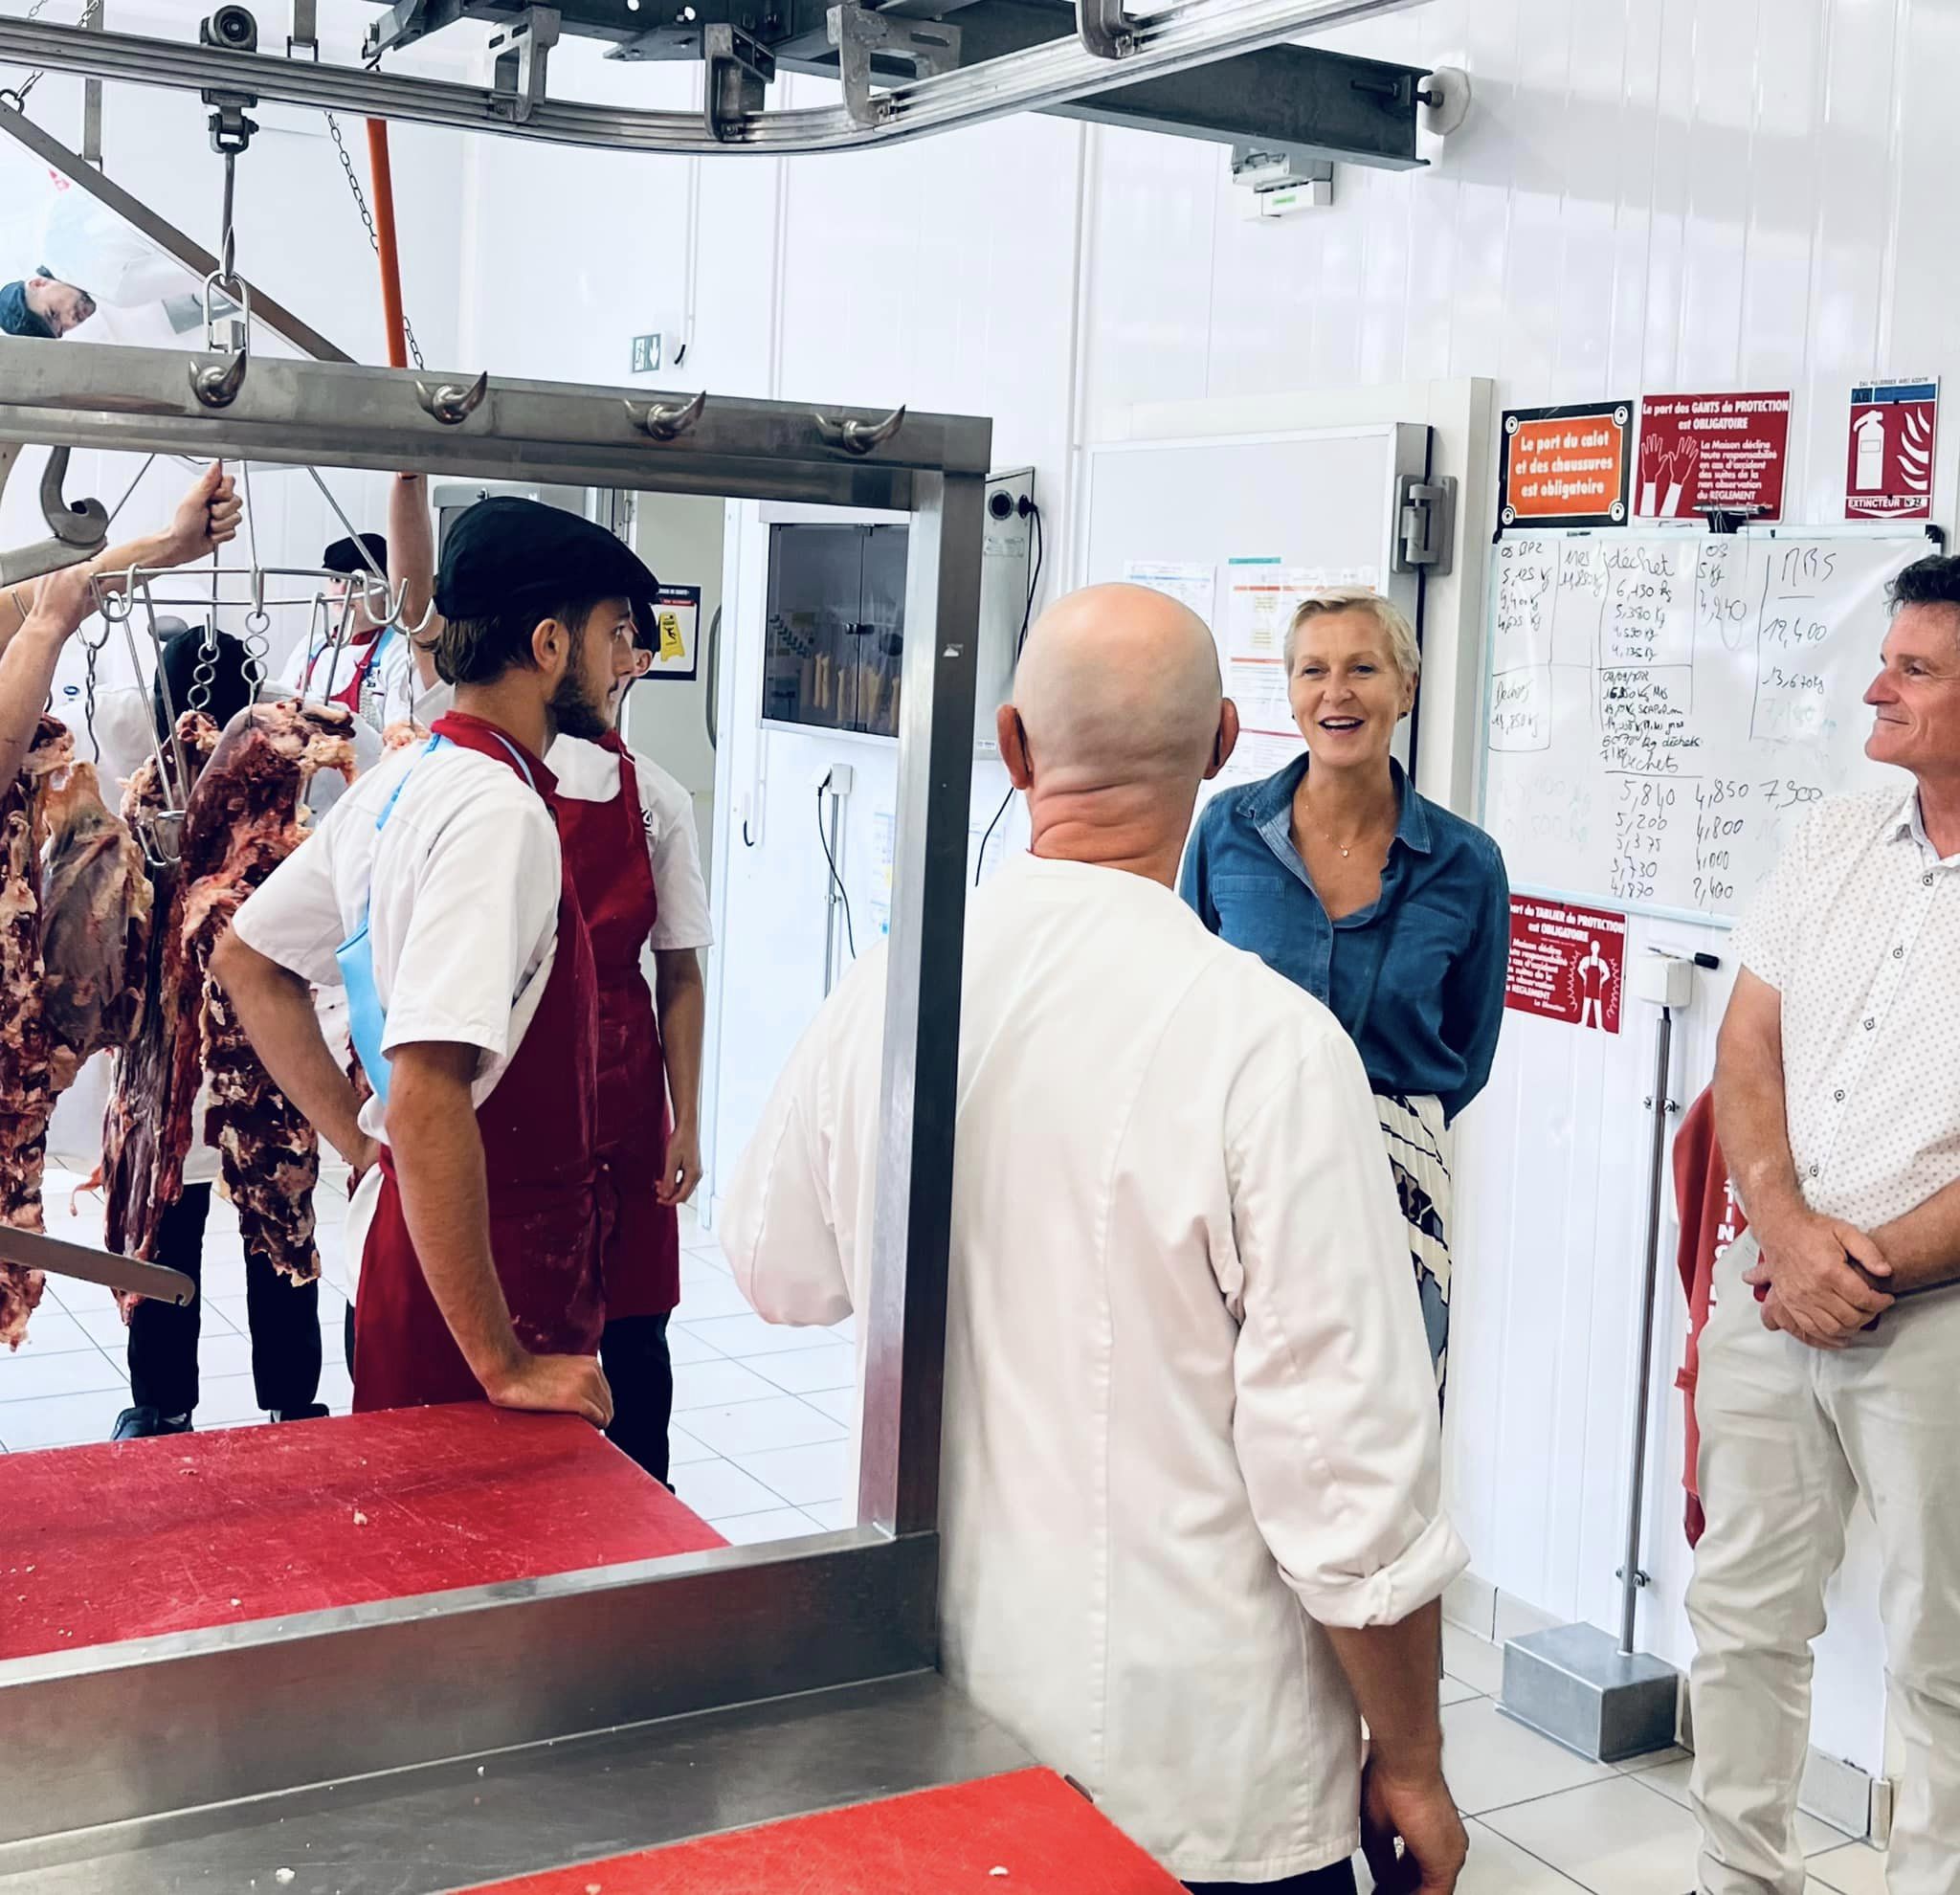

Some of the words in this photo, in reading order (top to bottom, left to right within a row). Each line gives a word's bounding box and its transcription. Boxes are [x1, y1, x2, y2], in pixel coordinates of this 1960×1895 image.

[1643, 403, 1653, 414] Le
[1654, 402, 1673, 416] port
[1674, 401, 1689, 413] des
[1691, 400, 1720, 413] GANTS
[1722, 400, 1733, 412] de
[1735, 399, 1789, 412] PROTECTION
[1678, 419, 1691, 430] est
[1693, 417, 1749, 430] OBLIGATOIRE
[1521, 435, 1533, 452] Le
[1536, 434, 1561, 455] port
[1563, 432, 1578, 449] du
[1581, 430, 1610, 448] calot
[1711, 439, 1741, 450] Maison
[1742, 438, 1771, 450] décline
[1515, 459, 1526, 475] et
[1529, 457, 1548, 474] des
[1551, 456, 1613, 473] chaussures
[1521, 481, 1538, 497] est
[1540, 478, 1605, 500] obligatoire
[1848, 499, 1900, 508] EXTINCTEUR
[1696, 778, 1749, 811] 4,850
[1541, 924, 1589, 942] OBLIGATOIRE
[1577, 914, 1625, 934] PROTECTION
